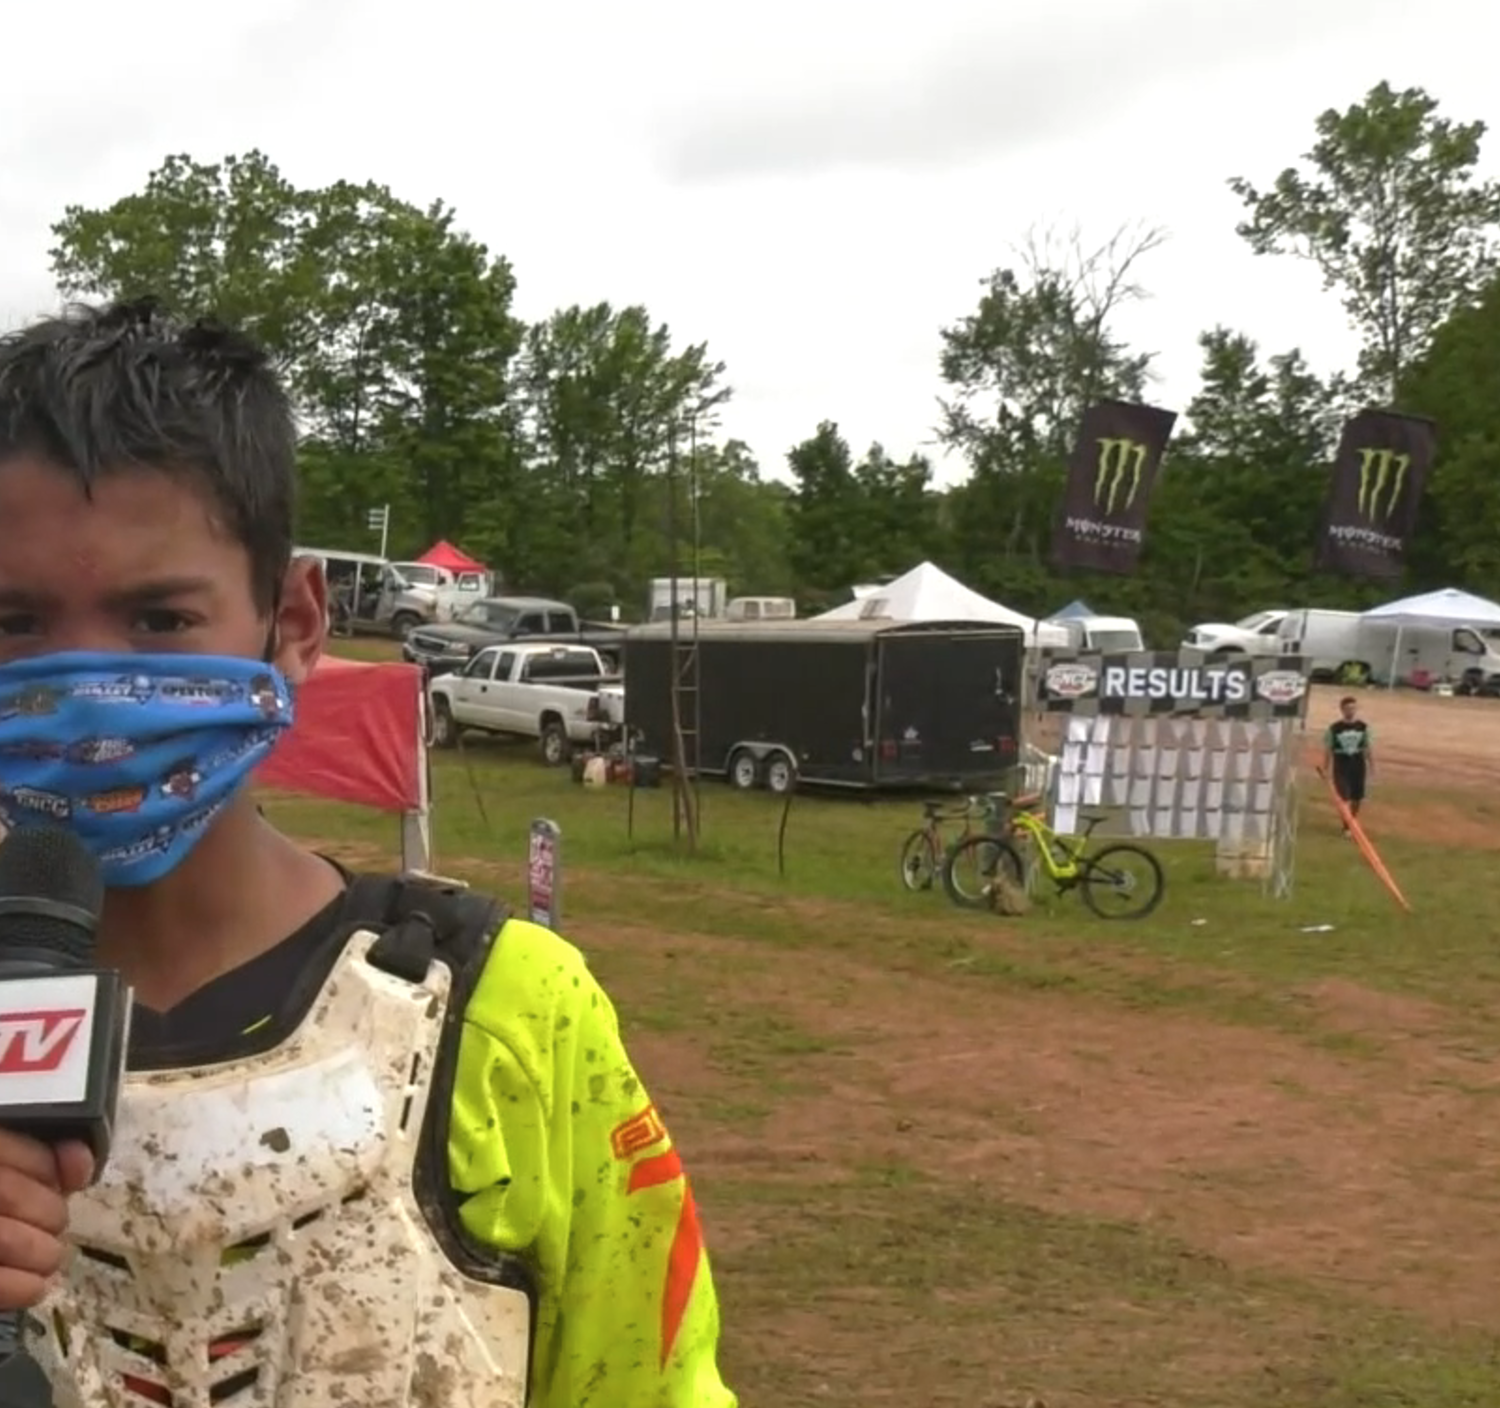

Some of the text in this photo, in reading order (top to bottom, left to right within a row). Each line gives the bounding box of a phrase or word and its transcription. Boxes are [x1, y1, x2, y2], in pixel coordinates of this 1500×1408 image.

[1065, 516, 1141, 543] MONSTER
[1329, 525, 1402, 551] MONSTER
[1105, 667, 1246, 700] RESULTS
